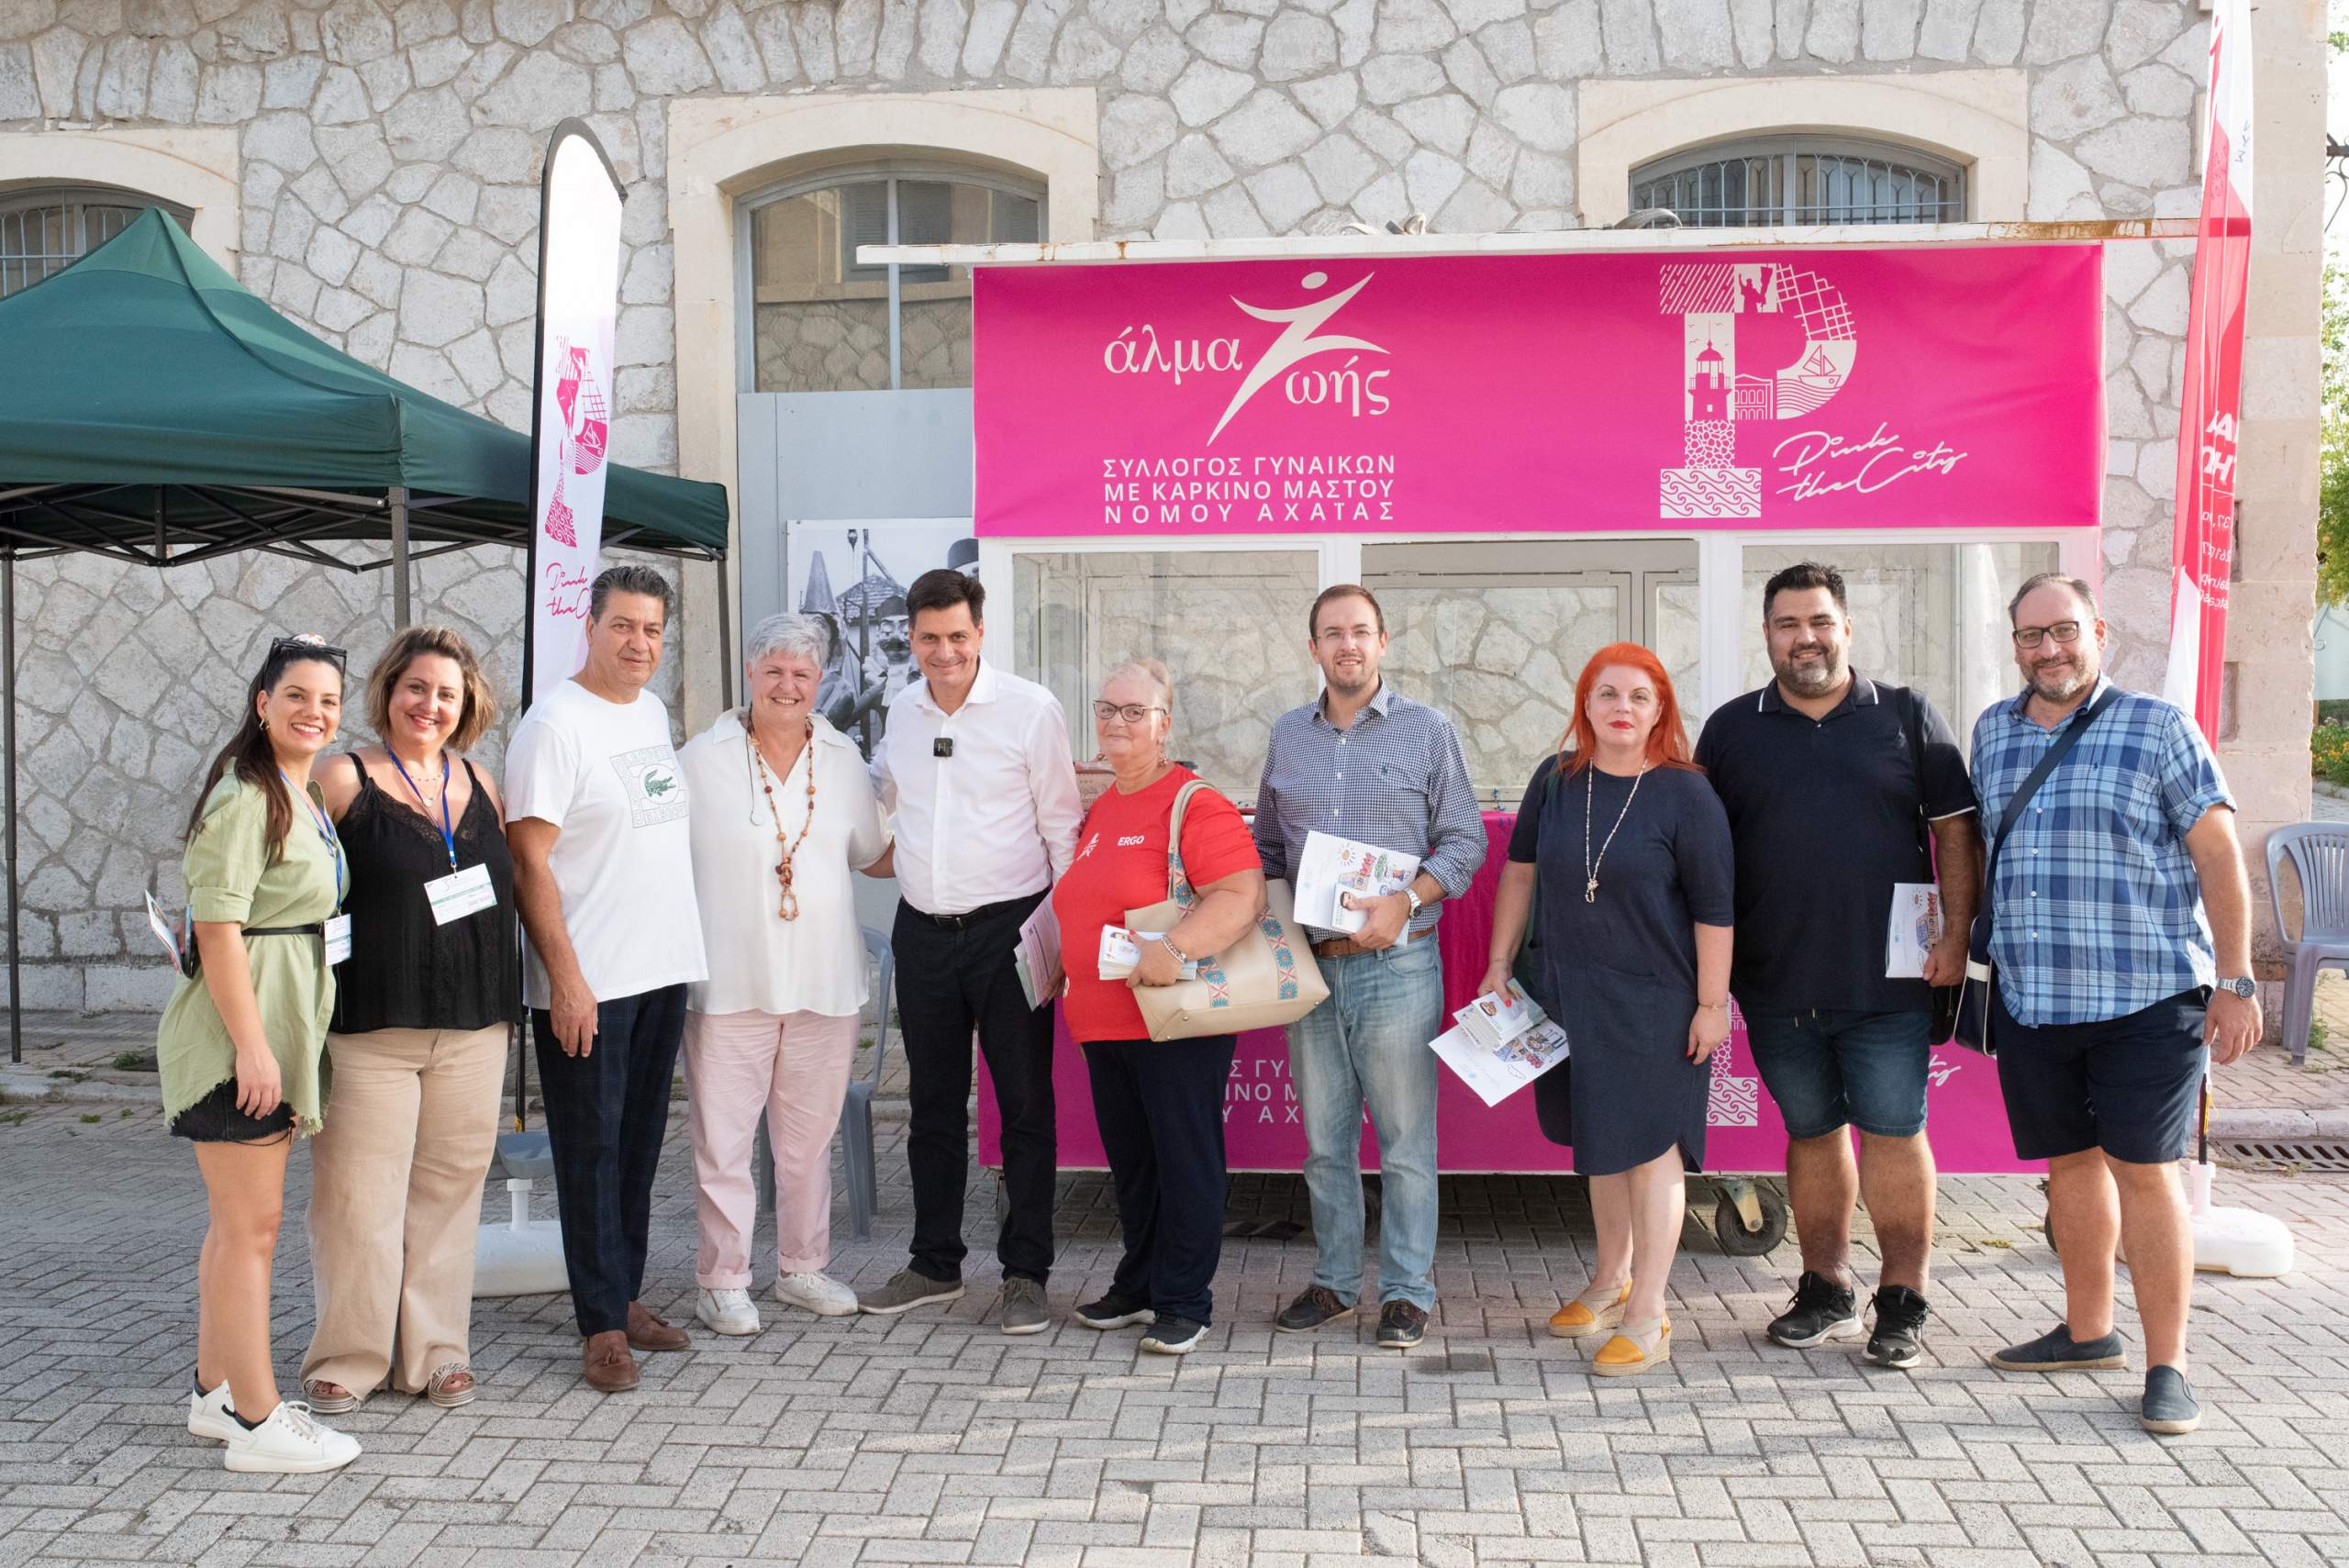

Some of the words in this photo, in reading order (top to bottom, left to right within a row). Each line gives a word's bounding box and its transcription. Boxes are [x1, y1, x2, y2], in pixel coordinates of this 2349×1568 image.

[1104, 324, 1243, 385] άλμα
[1772, 421, 1900, 477] Pink
[1103, 458, 1242, 478] ΣΥΛΛΟΓΟΣ
[1254, 455, 1395, 475] ΓΥΝΑΙΚΩΝ
[1776, 471, 1859, 502] the
[1855, 440, 1968, 494] City
[1104, 482, 1141, 502] ΜΕ
[1152, 481, 1272, 501] ΚΑΡΚΙΝΟ
[1284, 479, 1394, 499] ΜΑΣΤΟΥ
[1104, 504, 1232, 524] ΝΟΜΟΥ
[545, 562, 588, 591] Pink
[1118, 835, 1145, 847] ERGO
